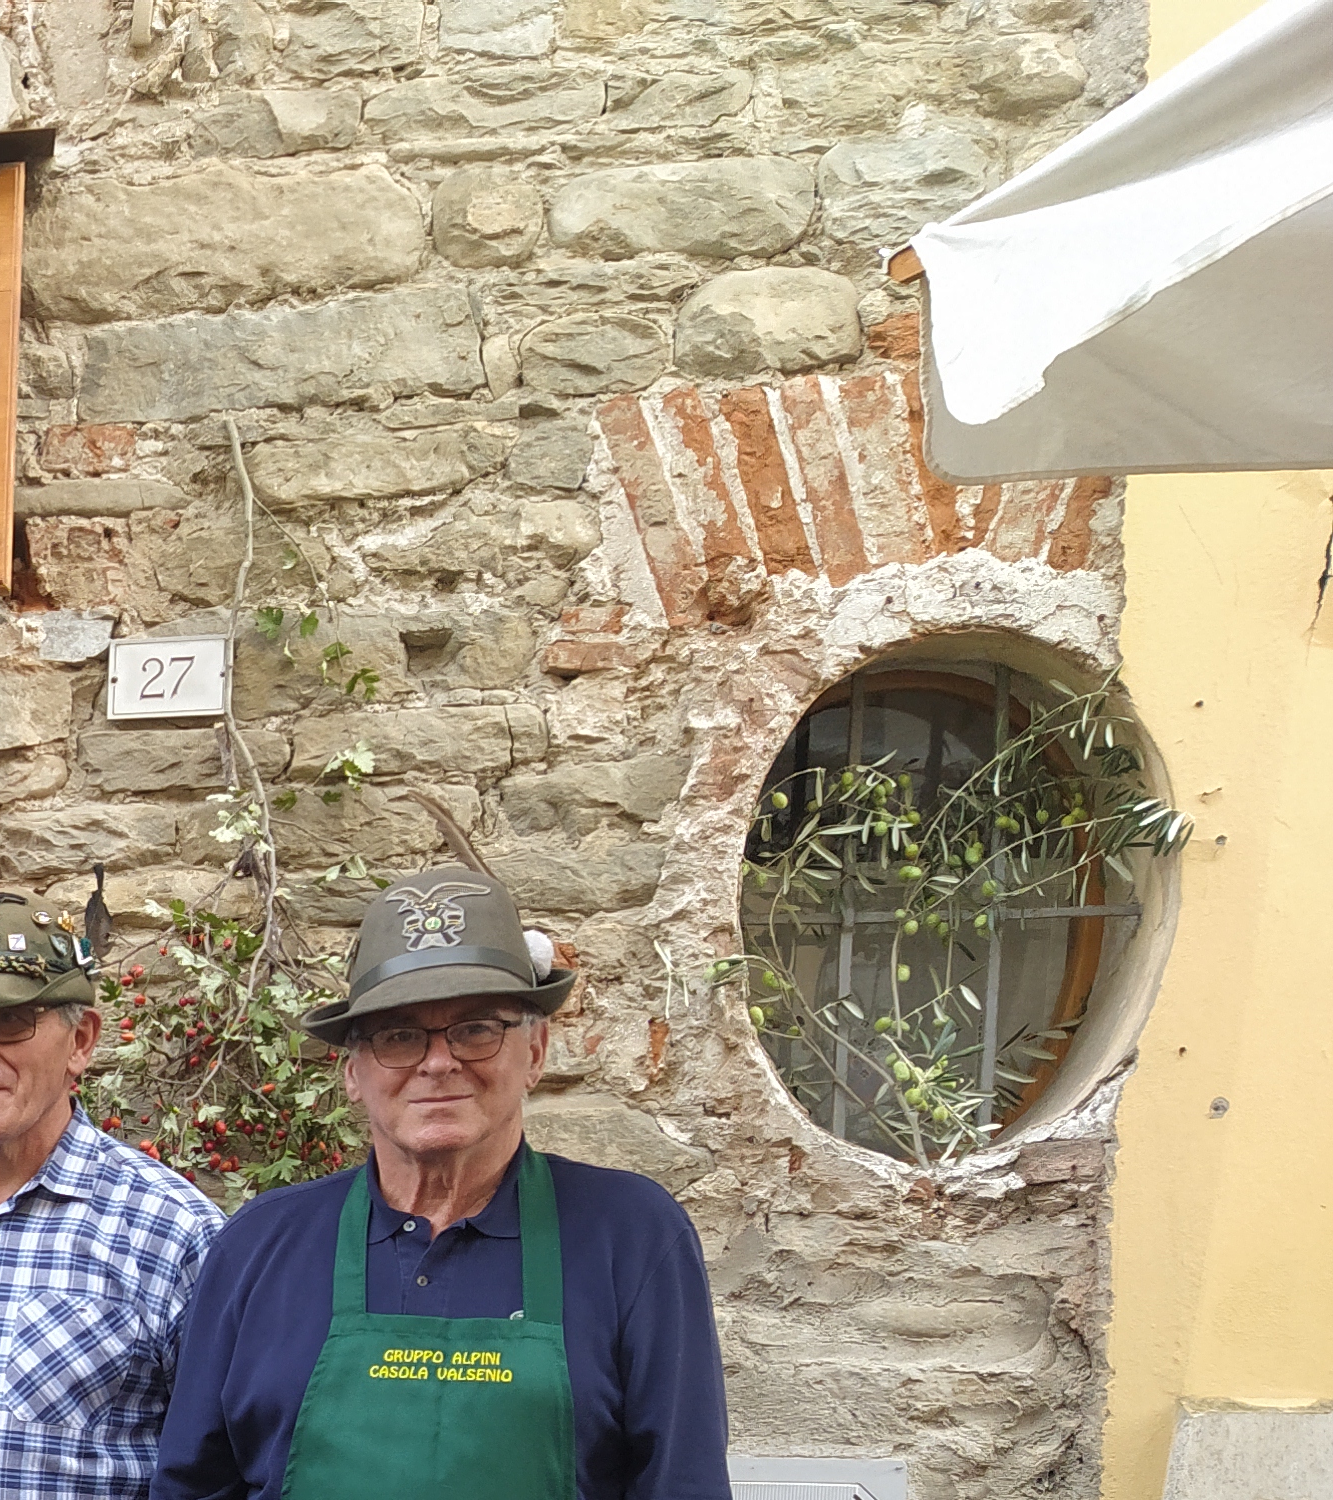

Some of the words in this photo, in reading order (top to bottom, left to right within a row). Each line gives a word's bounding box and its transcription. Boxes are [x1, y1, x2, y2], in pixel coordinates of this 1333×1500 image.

[138, 654, 197, 702] 27
[383, 1349, 444, 1364] GRUPPO
[451, 1351, 501, 1366] ALPINI
[369, 1365, 429, 1380] CASOLA
[436, 1367, 513, 1383] VALSENIO
